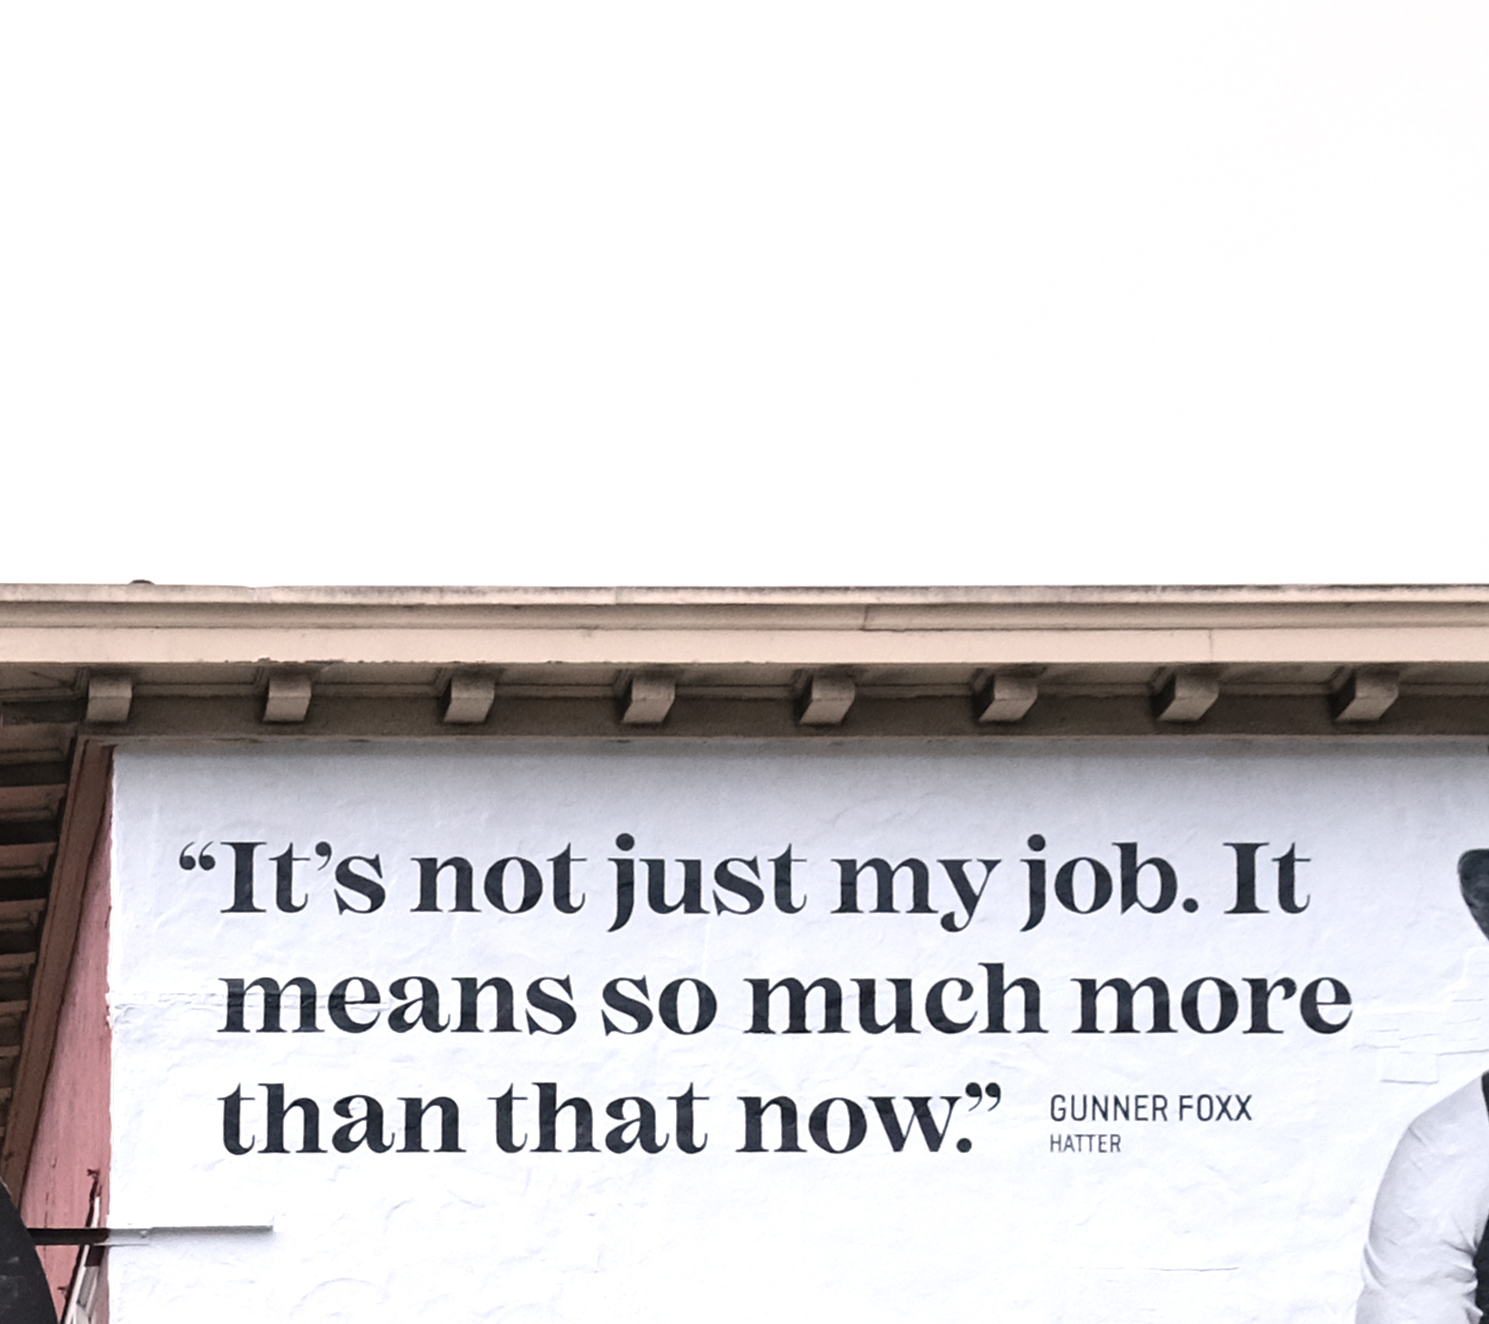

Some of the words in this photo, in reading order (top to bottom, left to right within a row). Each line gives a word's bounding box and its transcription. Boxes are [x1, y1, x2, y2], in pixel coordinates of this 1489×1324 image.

[410, 843, 587, 915] not
[607, 832, 807, 933] just
[830, 857, 1002, 933] my
[1020, 833, 1199, 933] job.
[1223, 842, 1311, 915] It
[217, 974, 577, 1036] means
[601, 976, 718, 1037] so
[743, 962, 1049, 1035] much
[1070, 976, 1353, 1035] more
[217, 1082, 467, 1156] than
[488, 1081, 710, 1155] that
[1049, 1133, 1122, 1154] HATTER
[1050, 1094, 1168, 1122] GUNNER
[1178, 1093, 1252, 1122] FOXX
